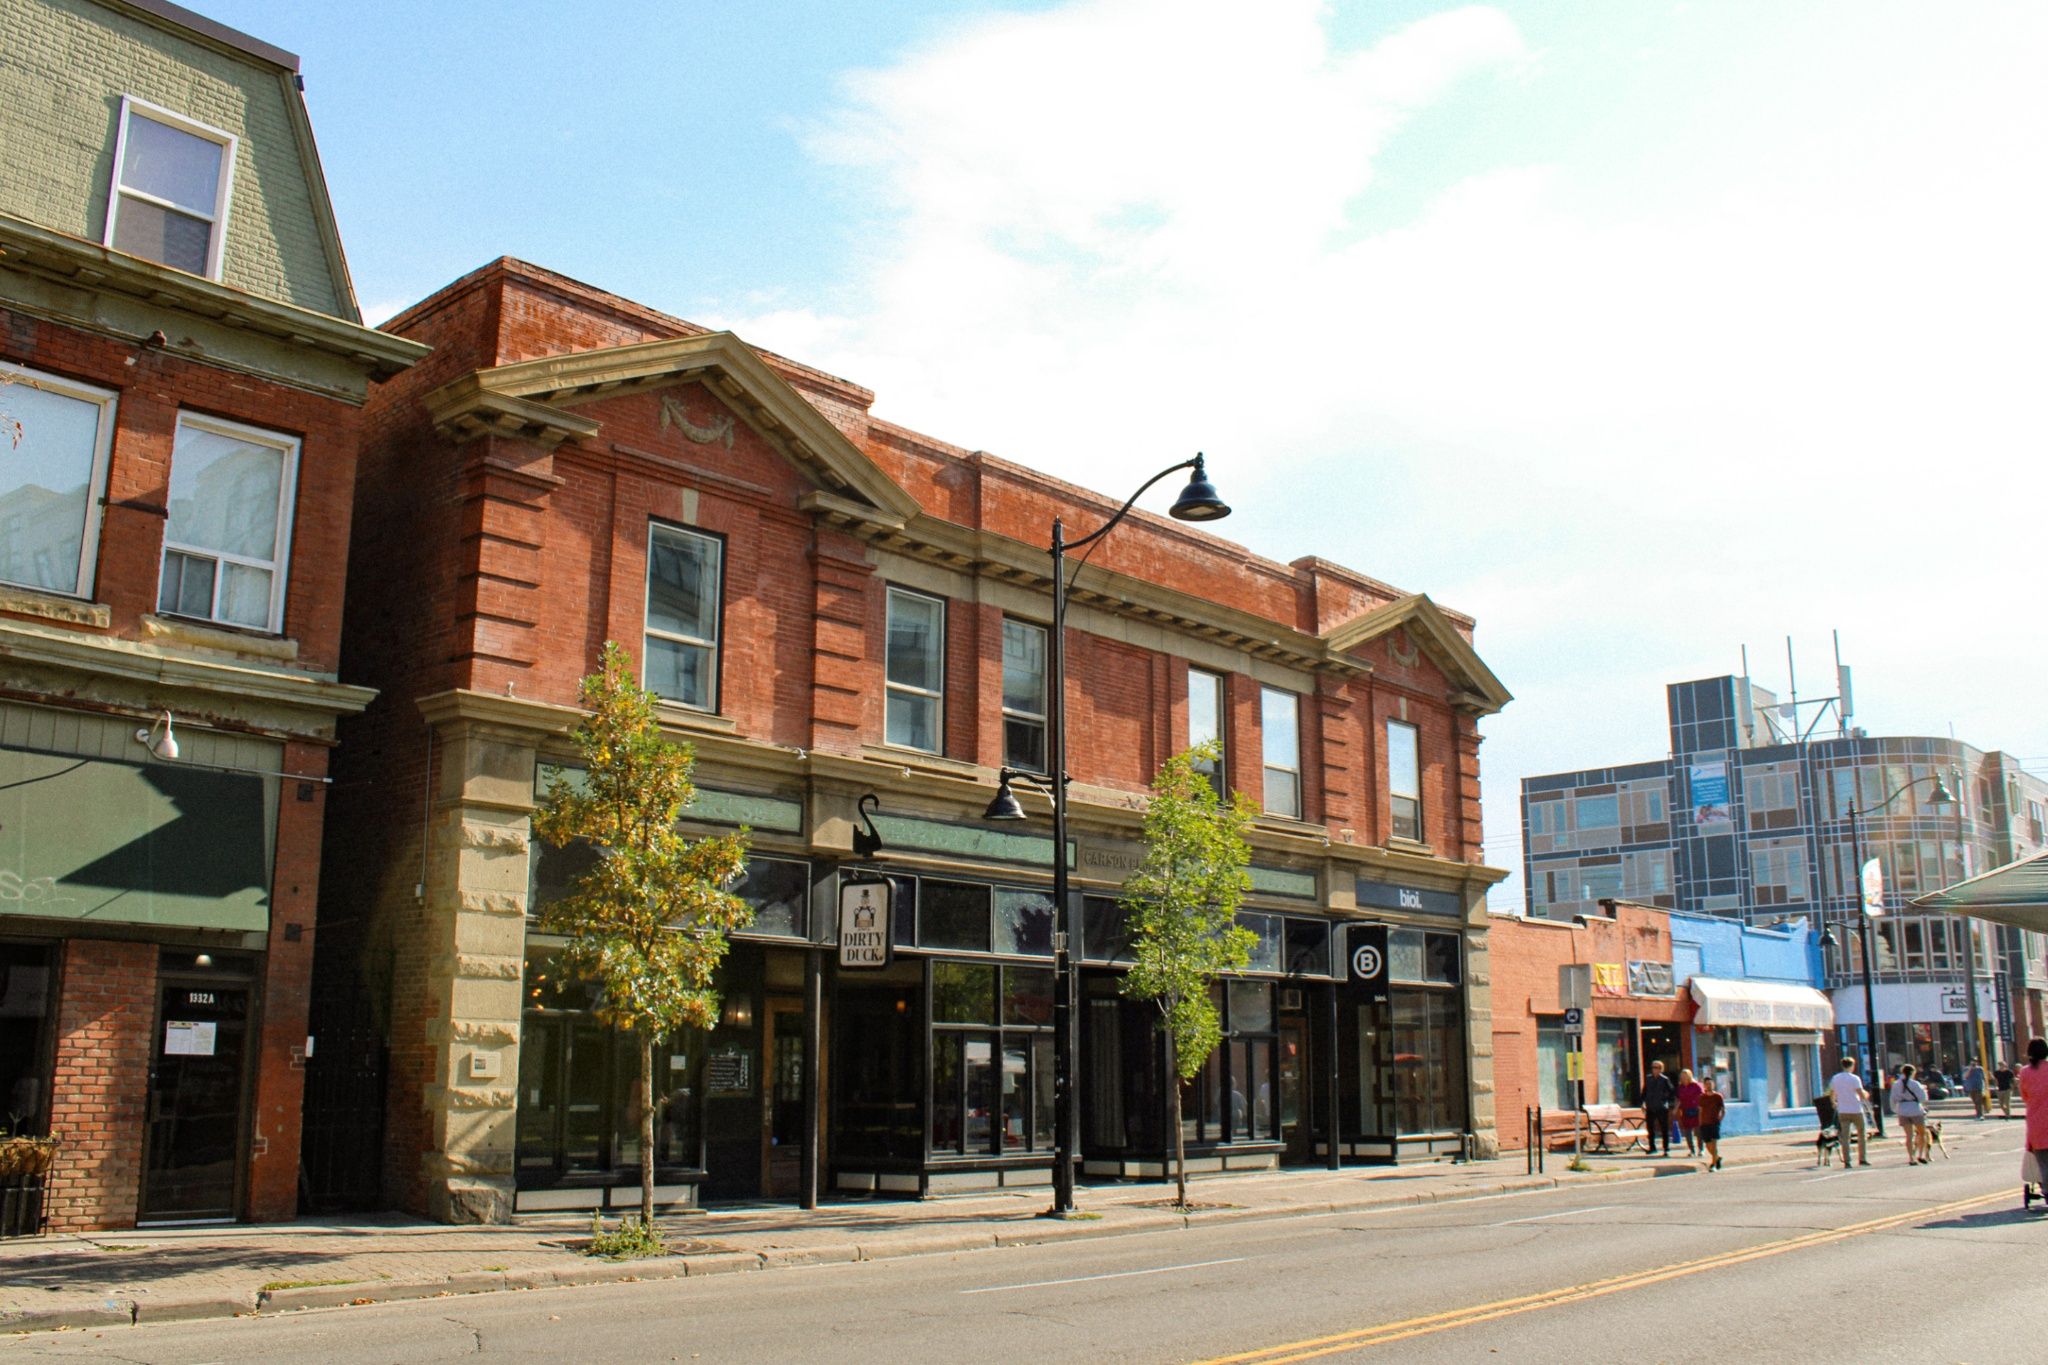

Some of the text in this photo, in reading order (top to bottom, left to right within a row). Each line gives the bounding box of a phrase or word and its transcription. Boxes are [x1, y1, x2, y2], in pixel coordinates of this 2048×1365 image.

[844, 932, 884, 947] DIRTY
[1360, 952, 1375, 972] B
[190, 993, 214, 1004] 1332A
